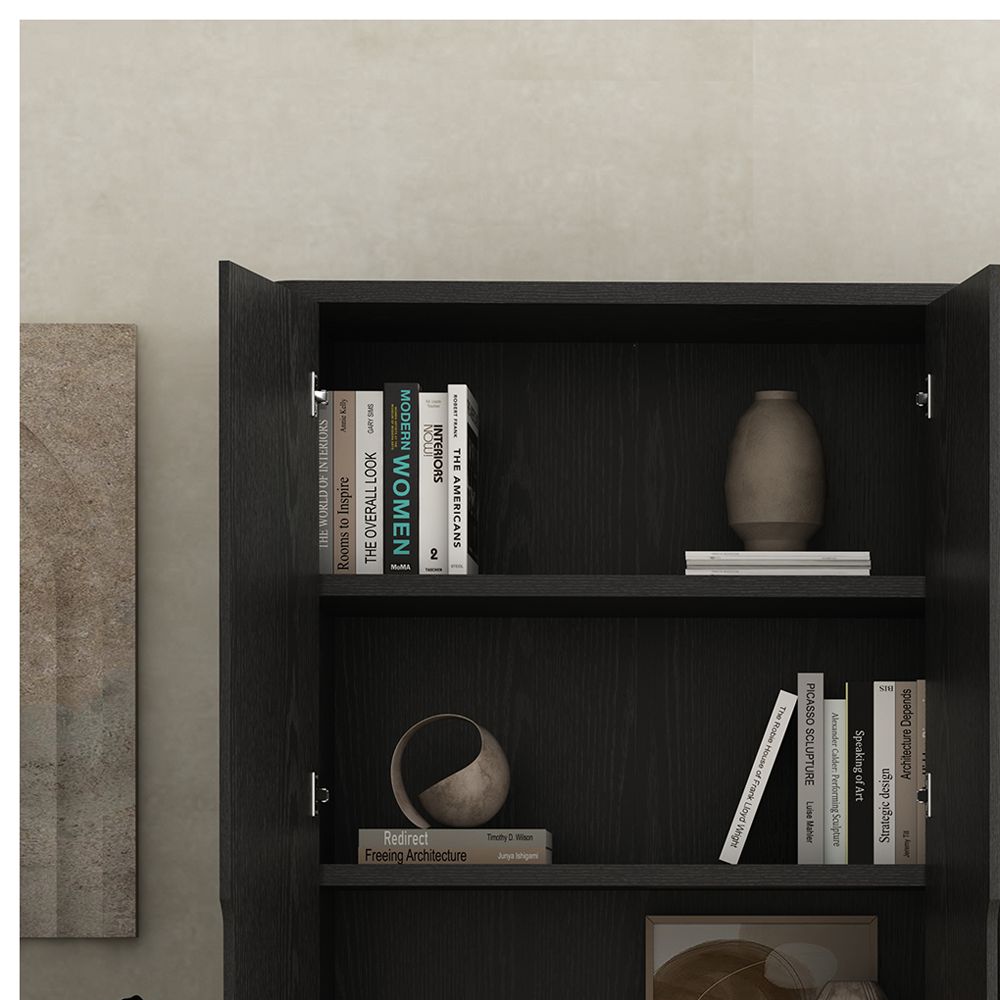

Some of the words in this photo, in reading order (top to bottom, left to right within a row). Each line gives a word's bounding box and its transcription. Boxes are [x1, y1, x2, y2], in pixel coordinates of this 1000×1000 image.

[340, 399, 348, 414] Kelly
[367, 403, 375, 418] SIMS
[367, 418, 375, 434] GARY
[400, 389, 411, 451] MODERN
[318, 419, 329, 472] INTERIORS
[433, 424, 443, 483] INTERIORS
[364, 452, 377, 484] LOOK
[453, 448, 461, 472] THE
[318, 474, 329, 488] OF
[337, 476, 352, 515] Inspire
[392, 454, 411, 555] WOMEN
[318, 491, 329, 527] WORLD
[364, 486, 377, 539] OVERALL
[453, 476, 462, 548] AMERICANS
[338, 518, 350, 529] to
[318, 529, 329, 549] THE
[337, 532, 350, 570] Rooms
[364, 541, 377, 565] THE
[430, 548, 438, 560] 2
[775, 705, 786, 721] The
[805, 683, 816, 726] PICASSO
[901, 688, 914, 727] Depends
[767, 722, 781, 743] Robie
[831, 712, 840, 747] Alexander
[758, 744, 773, 769] House
[804, 728, 815, 786] SCLUPTURE
[831, 748, 840, 773] Calder:
[853, 730, 865, 774] Speaking
[901, 728, 912, 780] Architecture
[754, 770, 764, 778] of
[855, 774, 865, 786] of
[878, 768, 893, 799] design
[747, 779, 760, 801] Frank
[830, 774, 840, 814] Performing
[856, 786, 865, 802] Art
[738, 802, 752, 823] Lloyd
[806, 801, 815, 819] Luise
[879, 802, 893, 843] Strategic
[384, 830, 429, 846] Redirect
[487, 833, 507, 842] Timothy
[730, 824, 745, 849] Wright
[806, 820, 815, 844] Mahler
[831, 814, 841, 847] Sculpture
[365, 849, 403, 864] Freeing
[406, 849, 467, 862] Architecture
[497, 852, 514, 862] Junya
[515, 852, 538, 862] Ishigami
